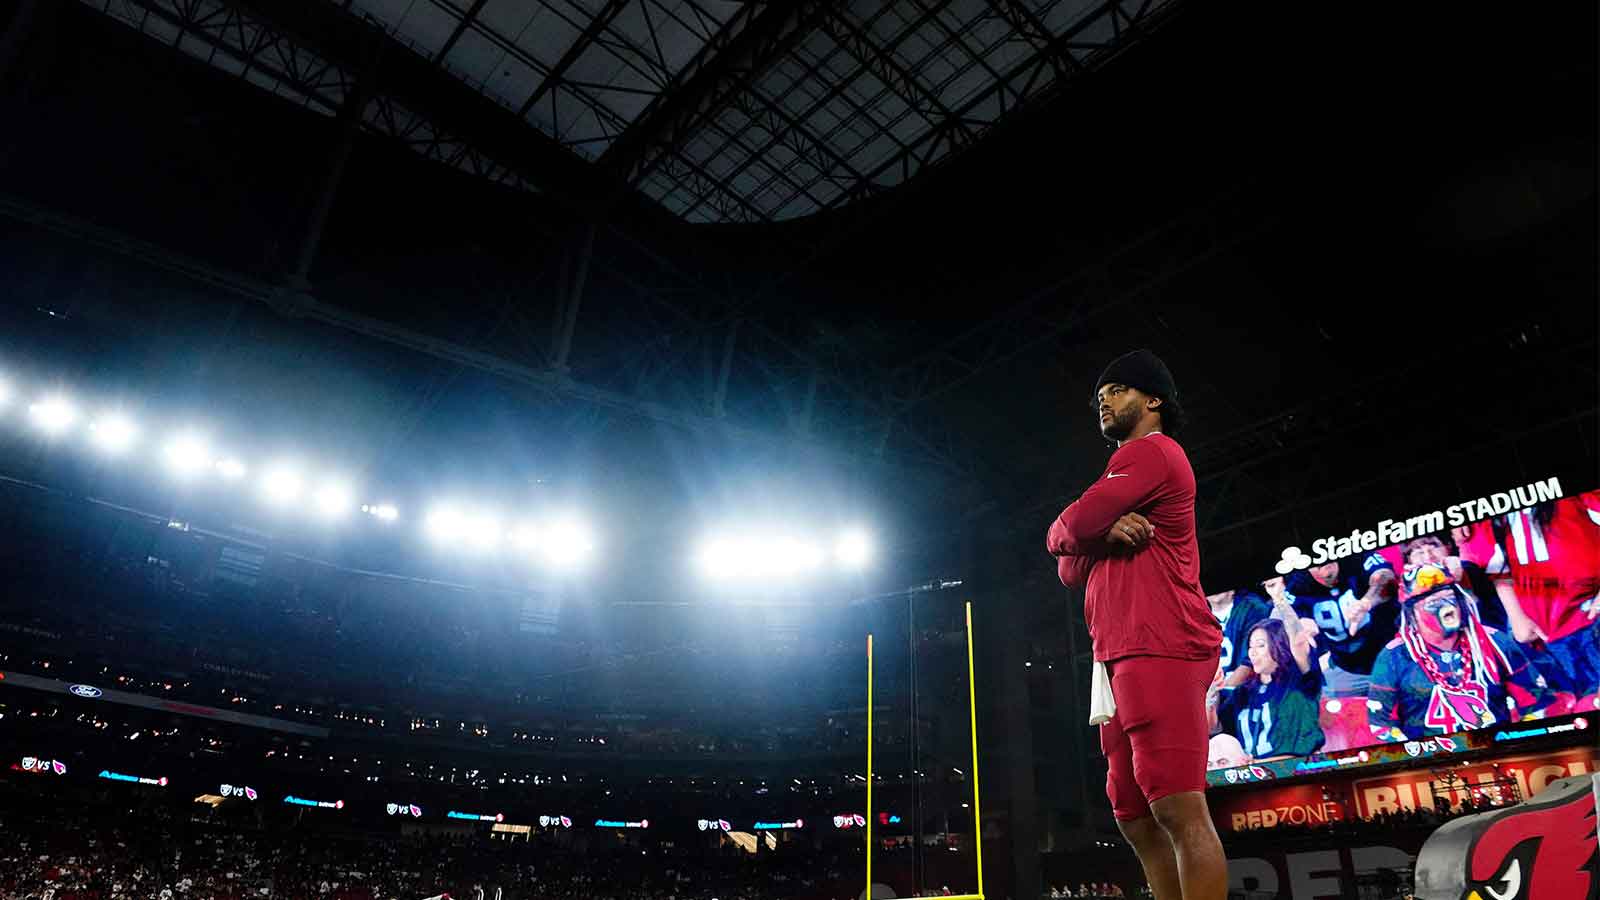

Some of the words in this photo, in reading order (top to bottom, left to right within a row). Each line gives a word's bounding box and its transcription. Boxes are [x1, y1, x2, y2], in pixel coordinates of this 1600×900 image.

[1447, 477, 1563, 526] STADIUM
[1420, 741, 1437, 752] VS
[37, 760, 50, 771] VS
[1238, 769, 1250, 780] VS
[232, 787, 244, 797] VS
[398, 806, 409, 815] VS
[550, 816, 560, 826] VS
[709, 821, 719, 830] VS
